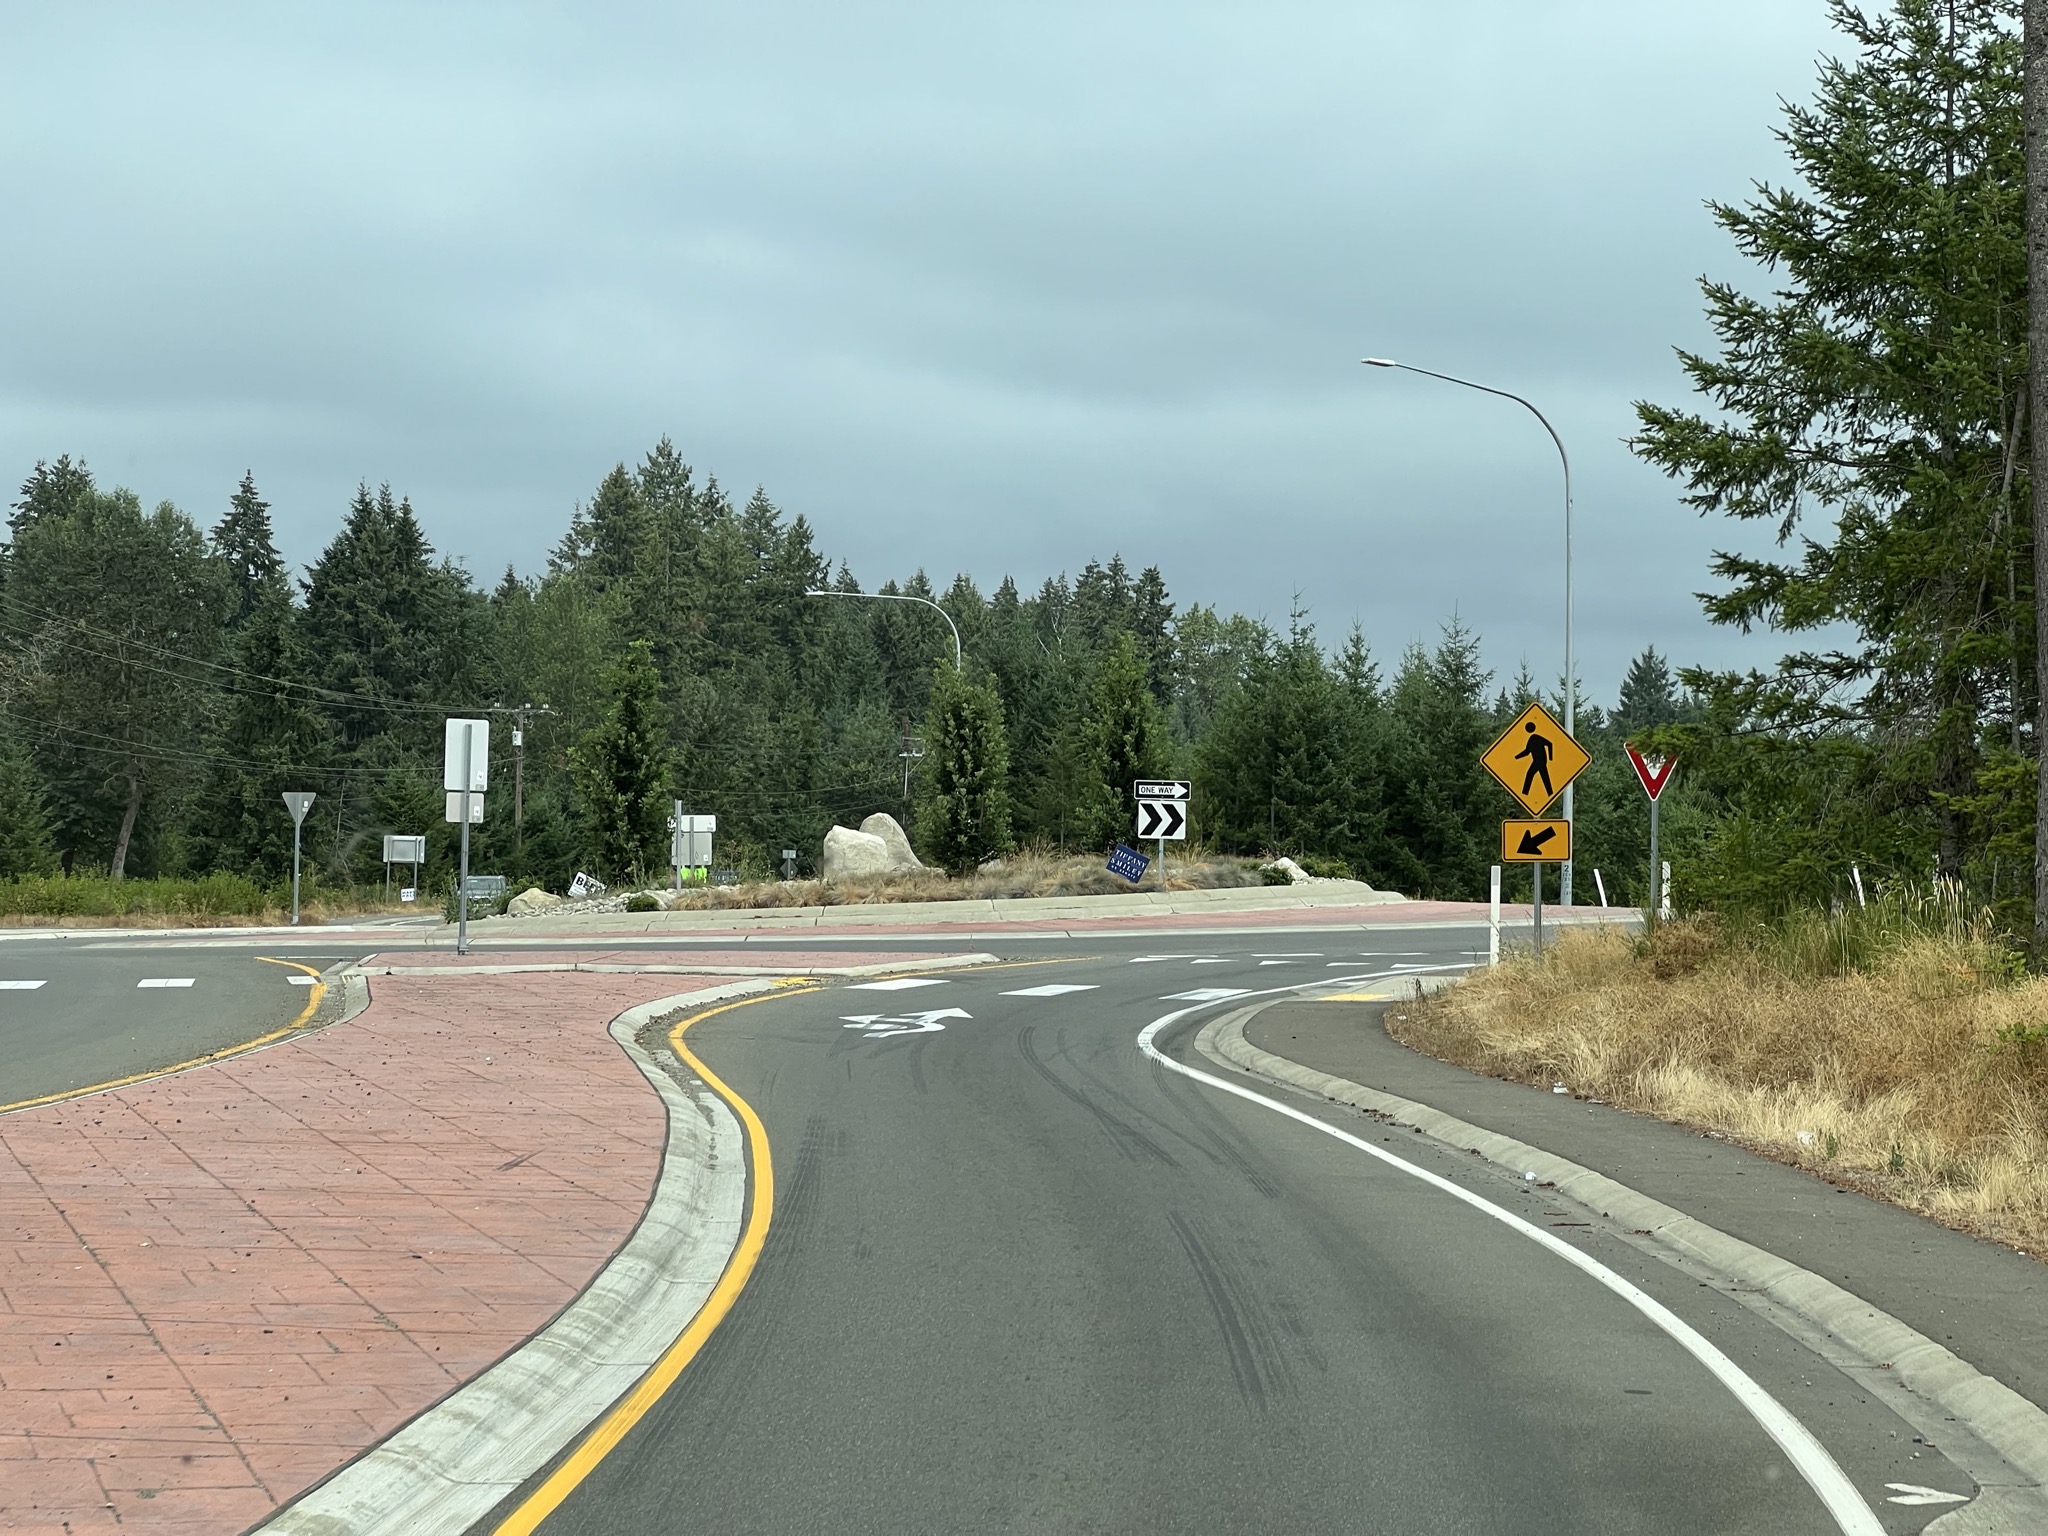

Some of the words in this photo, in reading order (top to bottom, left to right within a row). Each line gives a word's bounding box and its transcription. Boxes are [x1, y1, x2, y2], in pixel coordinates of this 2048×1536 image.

[1140, 786, 1156, 794] ONE
[1158, 786, 1174, 794] WAY
[1110, 857, 1143, 876] SMILEY
[1115, 849, 1147, 868] TIFFANY
